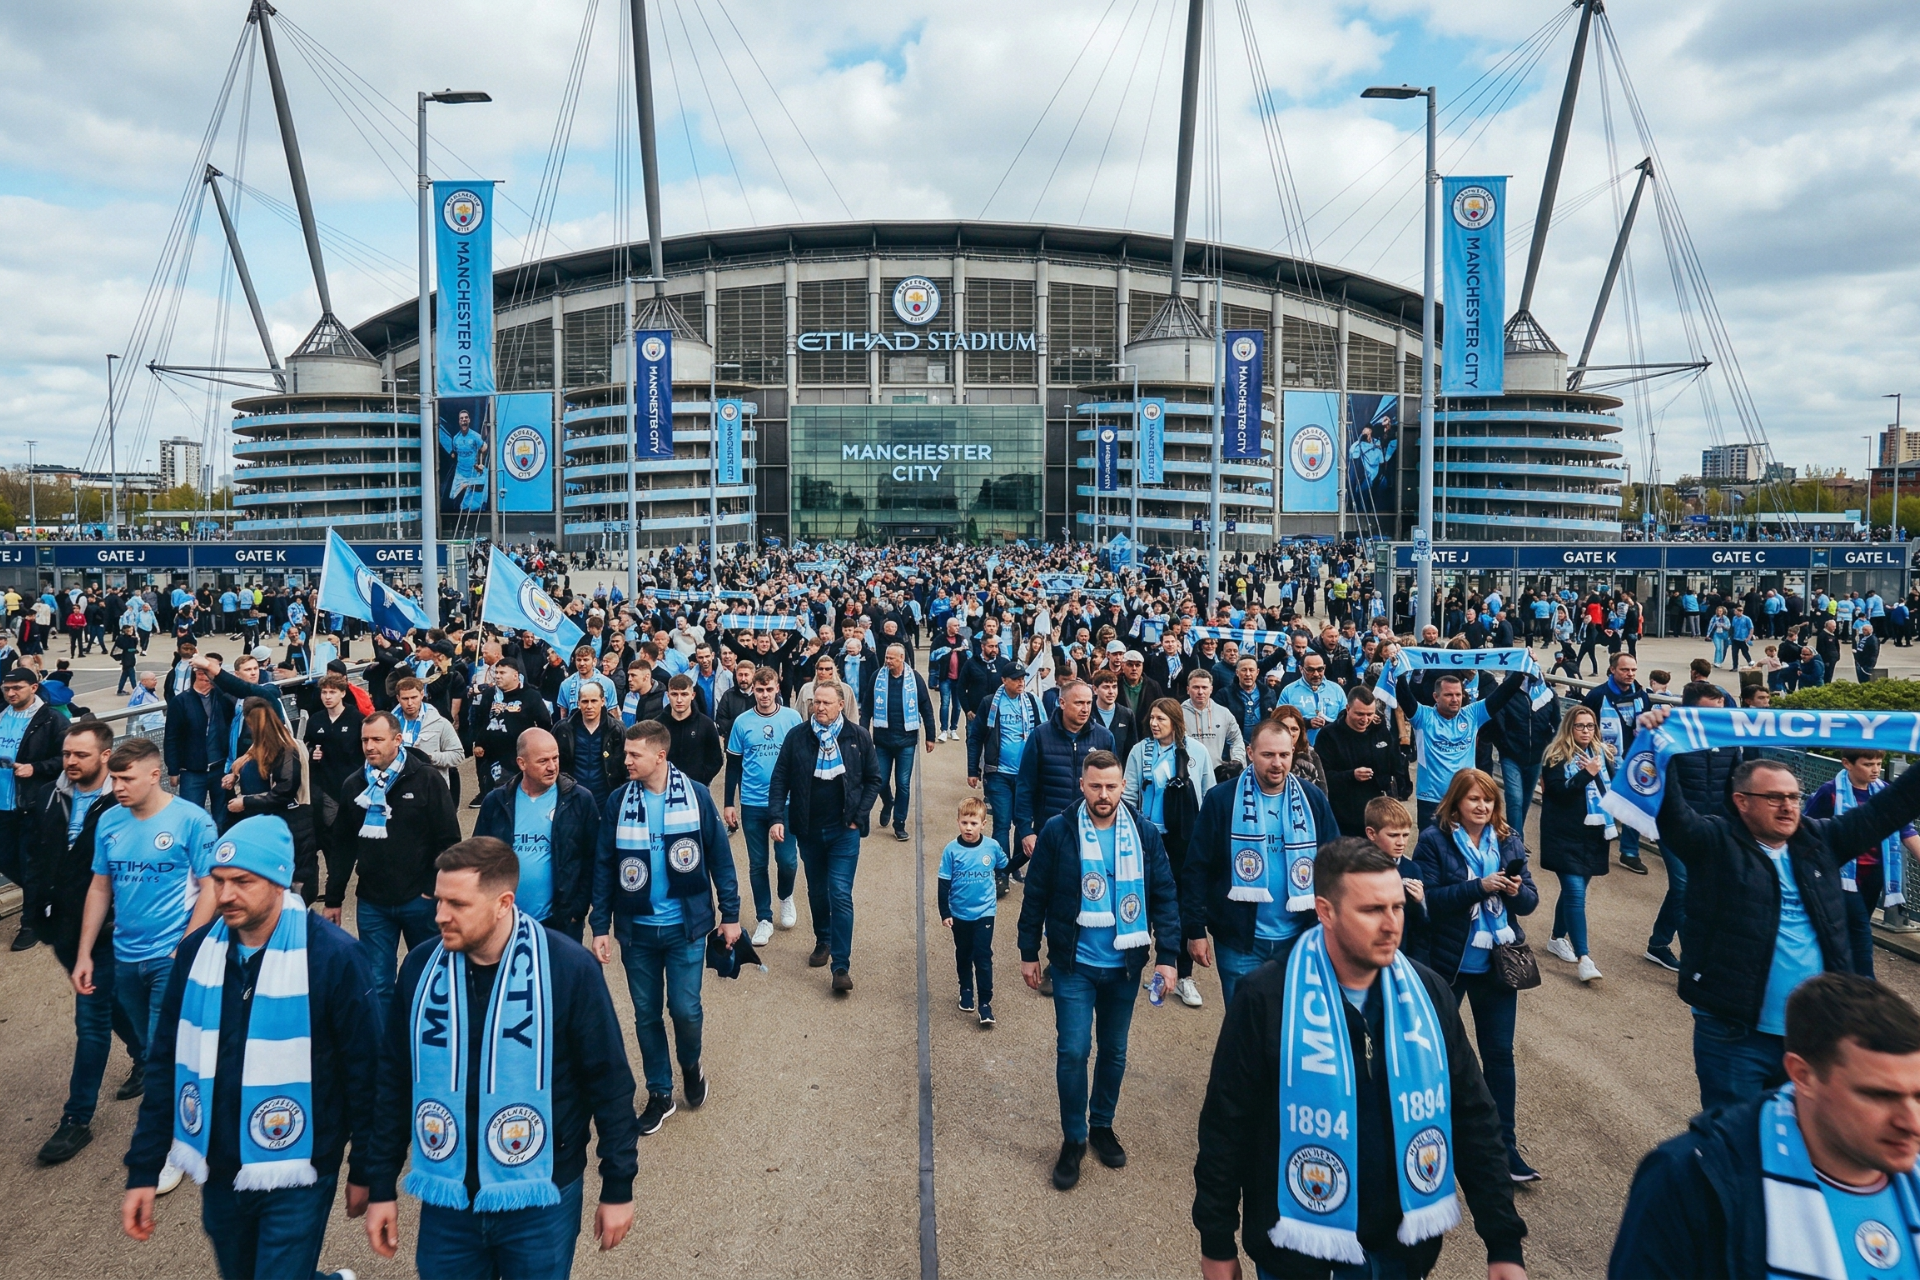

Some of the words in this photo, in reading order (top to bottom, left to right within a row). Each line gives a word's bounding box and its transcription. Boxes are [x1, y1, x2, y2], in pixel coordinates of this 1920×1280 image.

[457, 242, 471, 350] MANCHESTER
[1465, 238, 1480, 348] MANCHESTER
[797, 332, 920, 351] ETIHAD
[928, 332, 1036, 351] STADIUM
[458, 355, 472, 390] CITY
[1465, 353, 1478, 389] CITY
[842, 444, 992, 461] MANCHESTER
[892, 464, 942, 482] CITY
[98, 550, 134, 562] GATE
[138, 550, 145, 562] J
[235, 550, 272, 562] GATE
[276, 550, 286, 562] K
[376, 549, 413, 561] GATE
[1431, 551, 1457, 563] ATE
[1461, 551, 1469, 563] J
[1563, 551, 1603, 563] GATE
[1606, 551, 1617, 563] K
[1712, 551, 1751, 563] GATE
[1755, 551, 1766, 563] C
[1845, 552, 1882, 563] GATE
[1729, 711, 1892, 739] MCFY
[107, 860, 175, 873] ETIHAD
[1398, 1082, 1446, 1123] 1894
[1287, 1103, 1349, 1141] 1894
